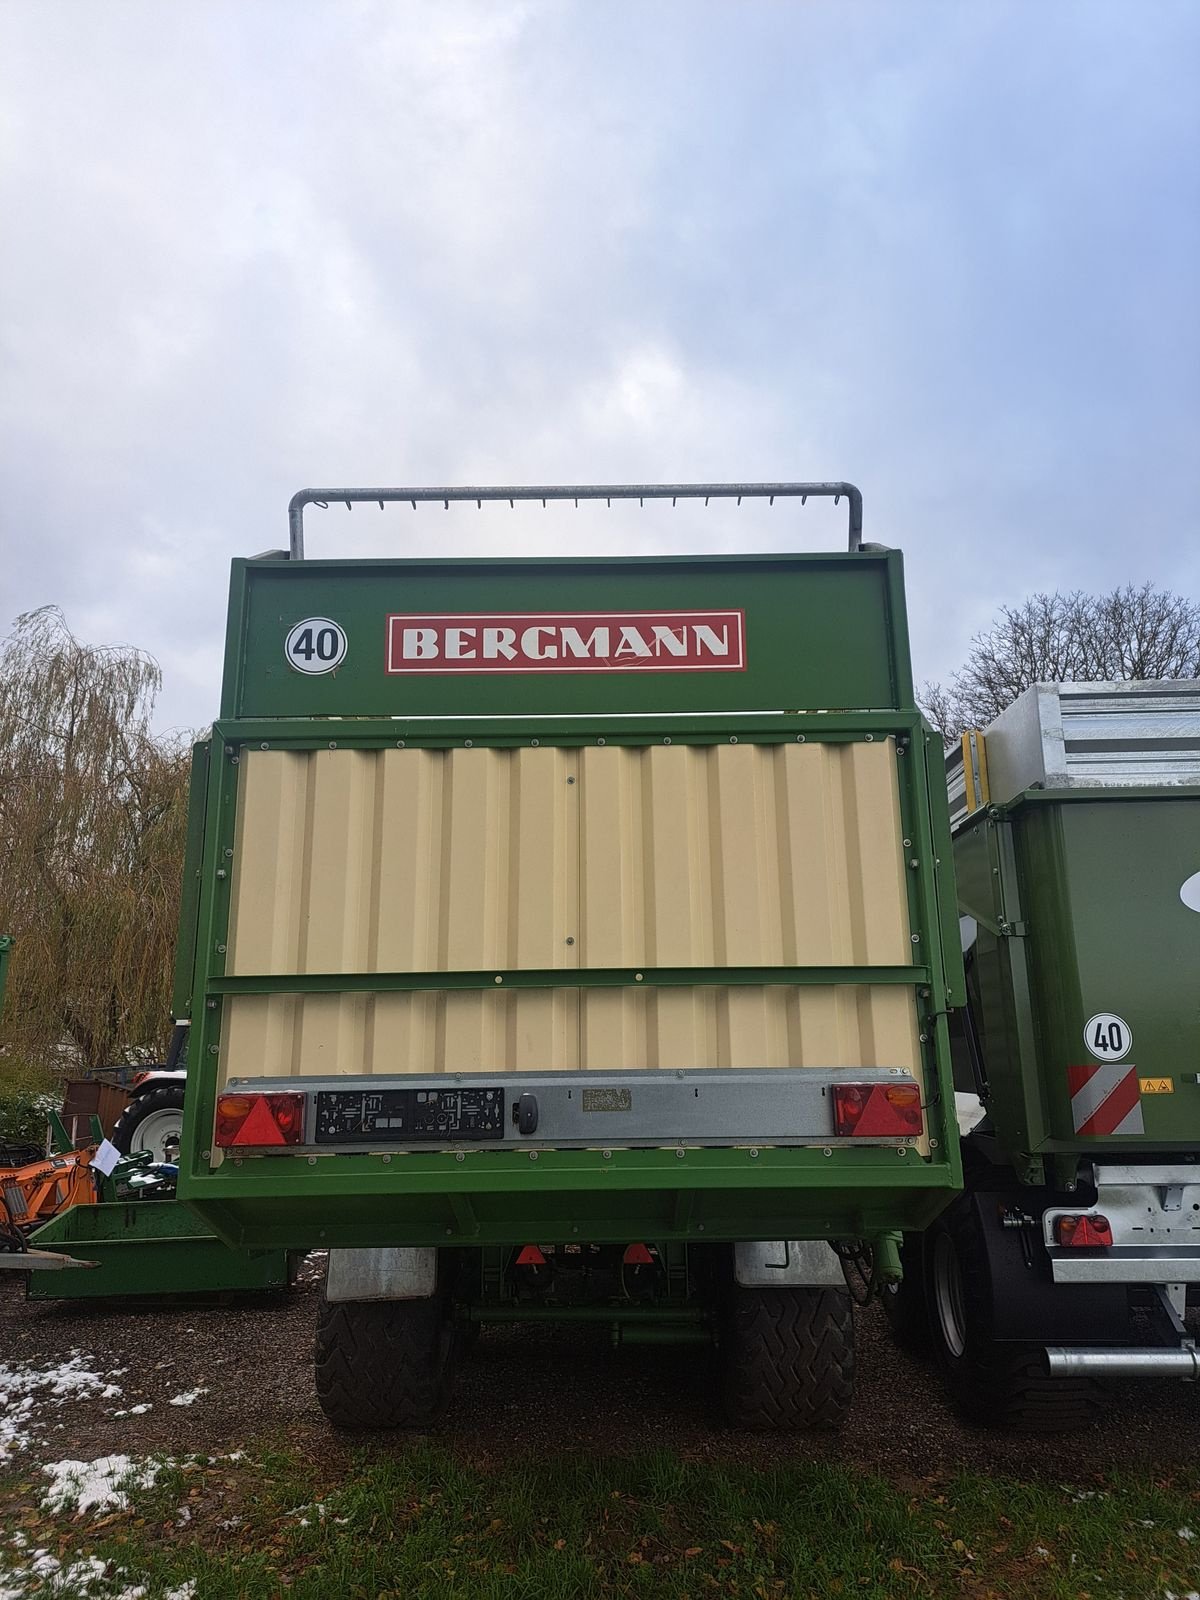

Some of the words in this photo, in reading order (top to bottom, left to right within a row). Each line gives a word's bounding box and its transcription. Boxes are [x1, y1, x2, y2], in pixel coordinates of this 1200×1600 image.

[292, 628, 339, 661] 40
[402, 625, 729, 661] BERGMANN
[1094, 1022, 1122, 1052] 40
